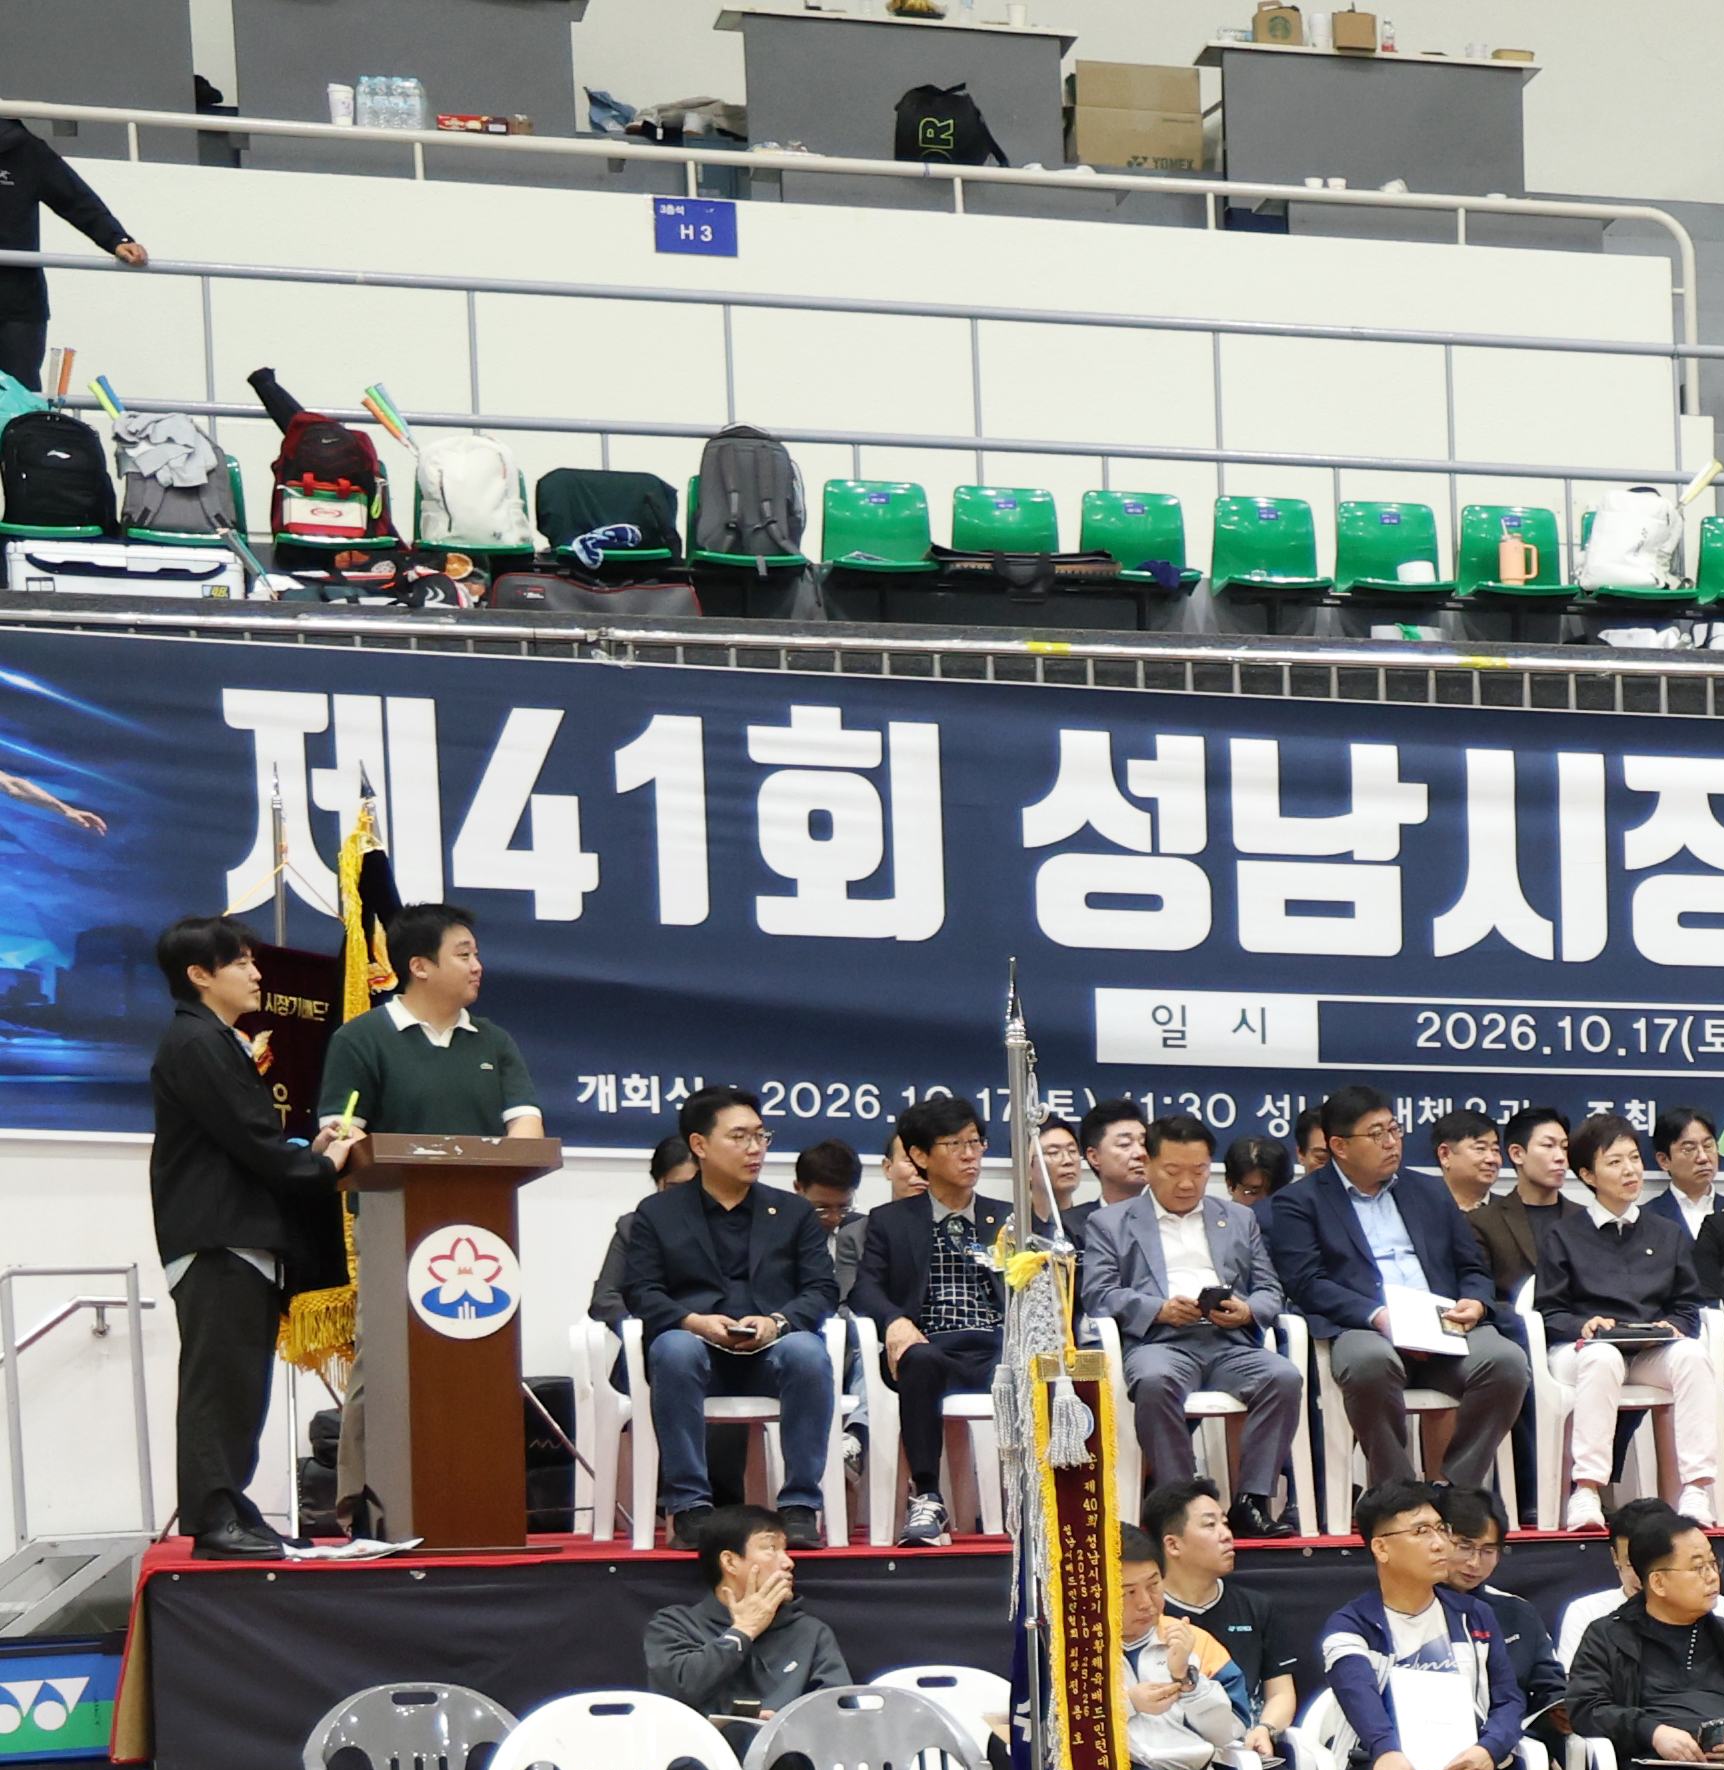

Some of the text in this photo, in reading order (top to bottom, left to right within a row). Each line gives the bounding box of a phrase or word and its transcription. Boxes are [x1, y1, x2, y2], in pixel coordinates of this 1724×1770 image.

[680, 223, 713, 242] H 3
[221, 687, 948, 942] 제41회
[1124, 1091, 1237, 1129] 1:30
